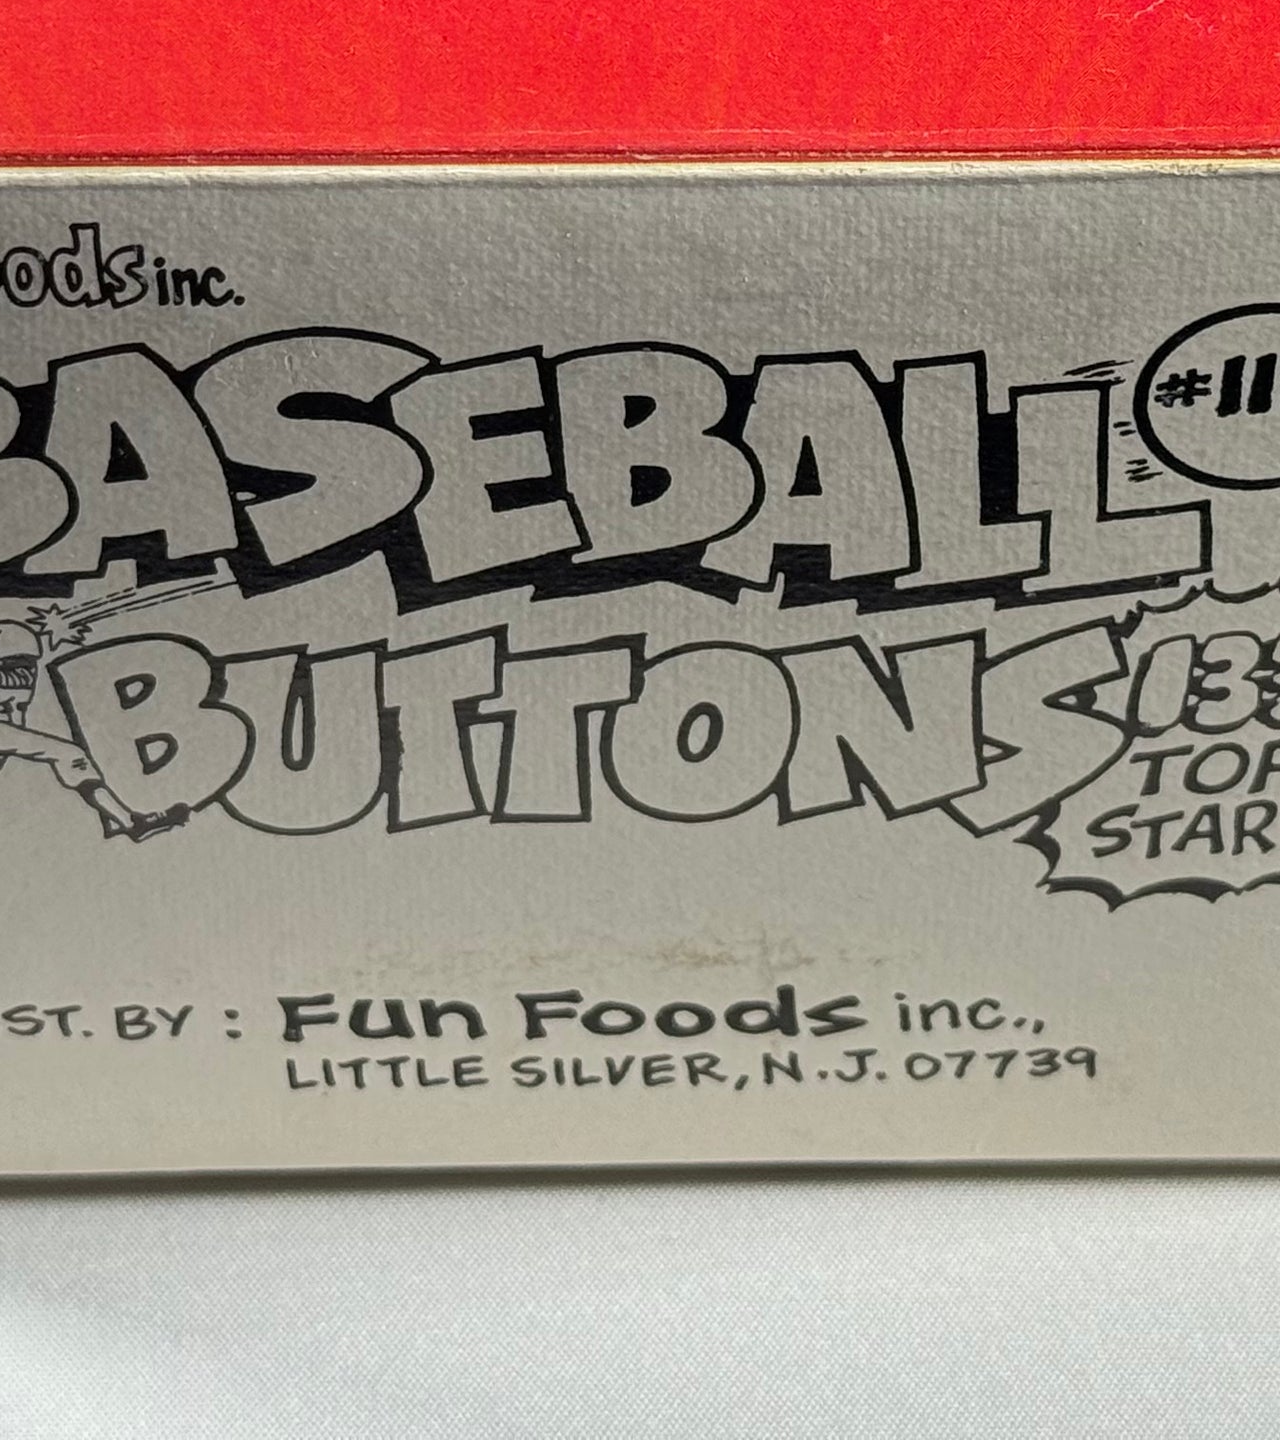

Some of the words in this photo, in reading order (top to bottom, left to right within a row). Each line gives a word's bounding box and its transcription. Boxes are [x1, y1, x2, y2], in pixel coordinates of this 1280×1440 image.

[153, 258, 246, 309] inc.
[50, 616, 1132, 837] BUTTONS
[277, 993, 489, 1044] Fun
[519, 984, 868, 1041] Foods
[895, 988, 1047, 1038] inc.,
[286, 1053, 490, 1091] LITTLE
[510, 1049, 750, 1092] SILVER,
[761, 1049, 889, 1084] N.J.
[904, 1046, 1099, 1081] 07739
